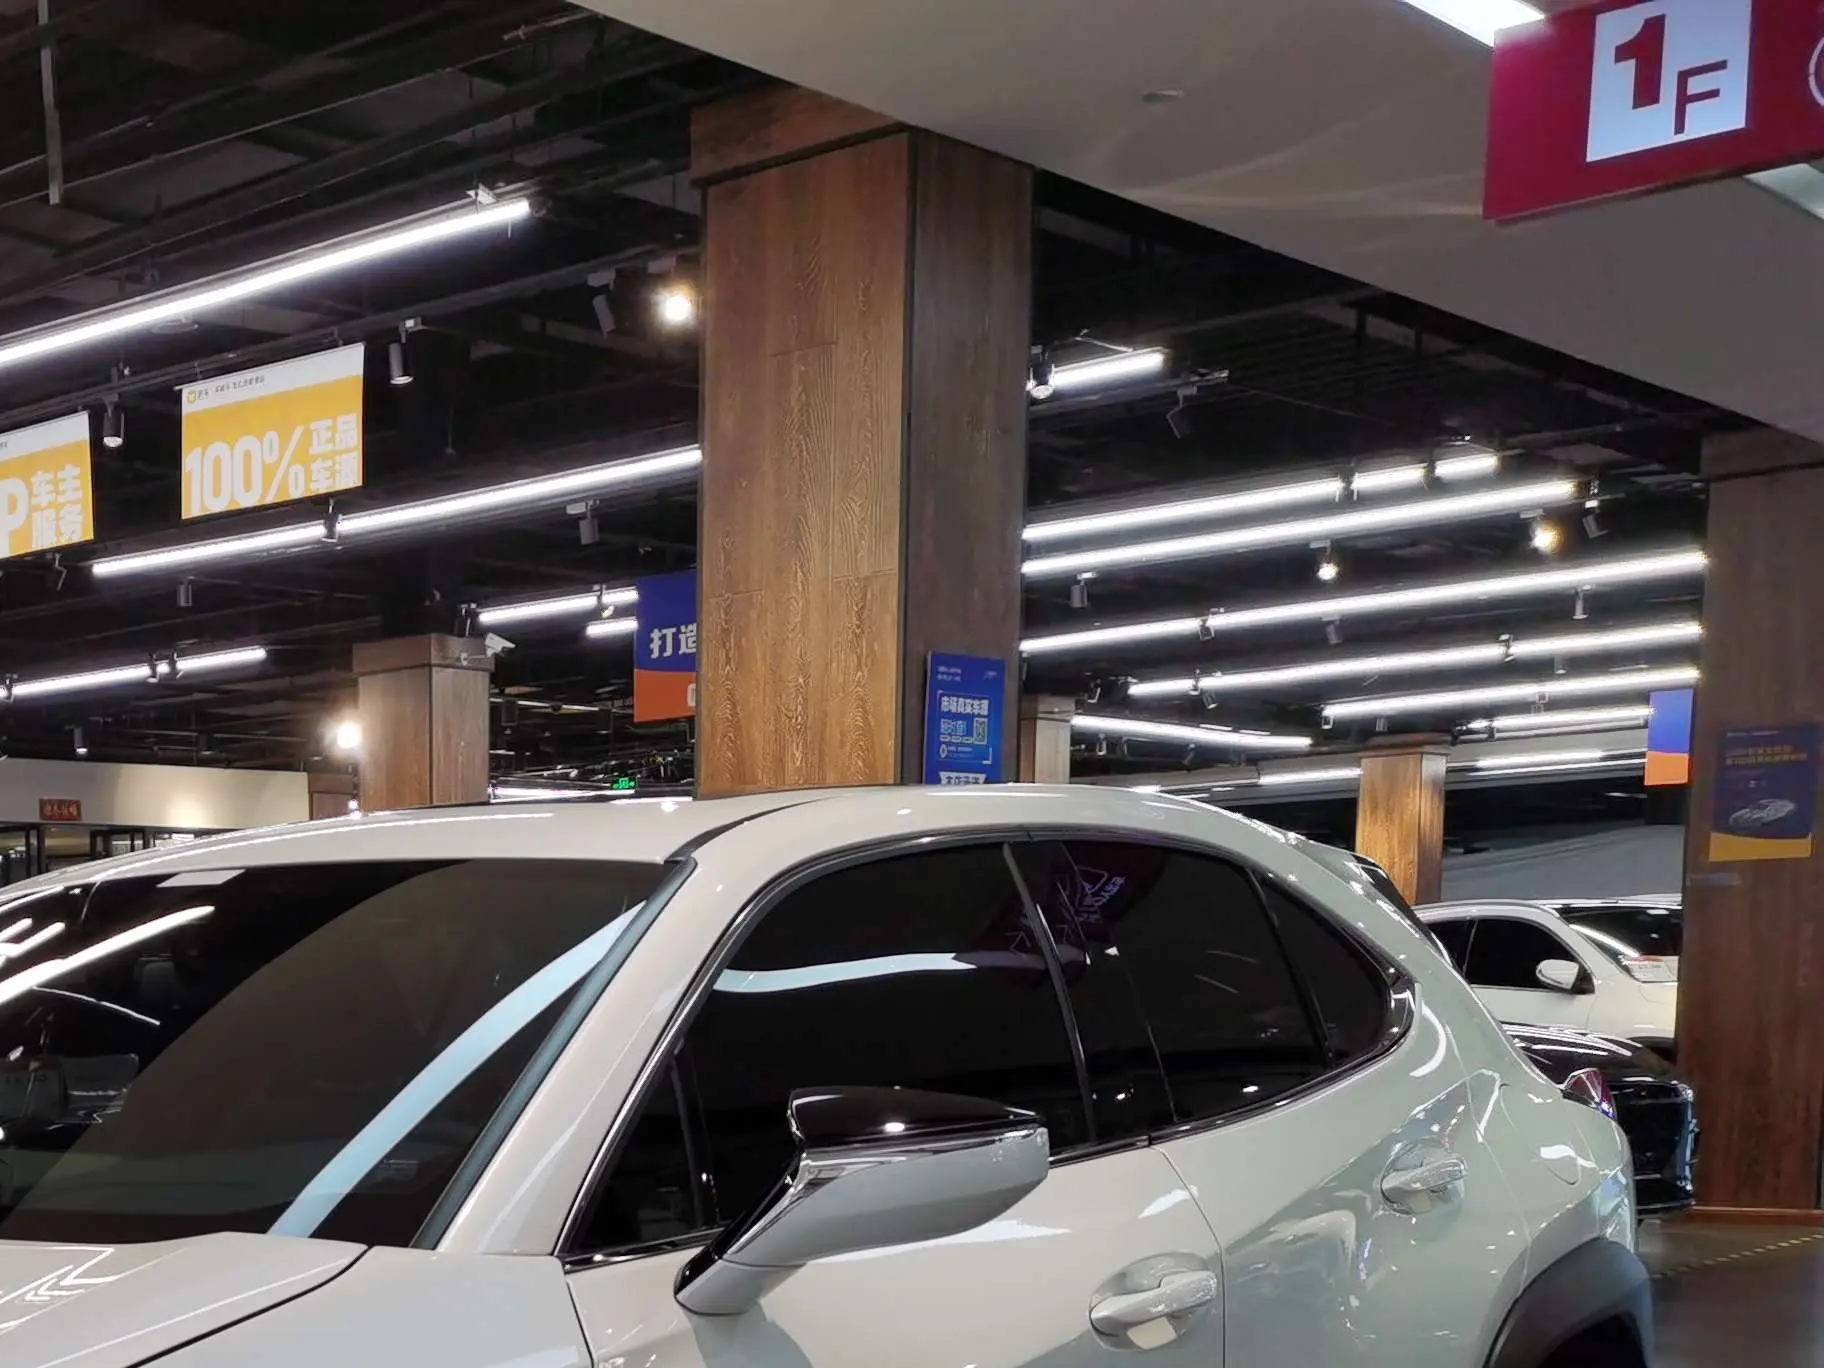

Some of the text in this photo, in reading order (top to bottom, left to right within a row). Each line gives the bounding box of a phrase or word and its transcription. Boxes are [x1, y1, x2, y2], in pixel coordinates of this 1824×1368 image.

[1614, 13, 1728, 135] 1F
[309, 413, 358, 455] 正品
[30, 463, 83, 508] 车主
[184, 426, 305, 517] 100%
[31, 504, 83, 551] 服务
